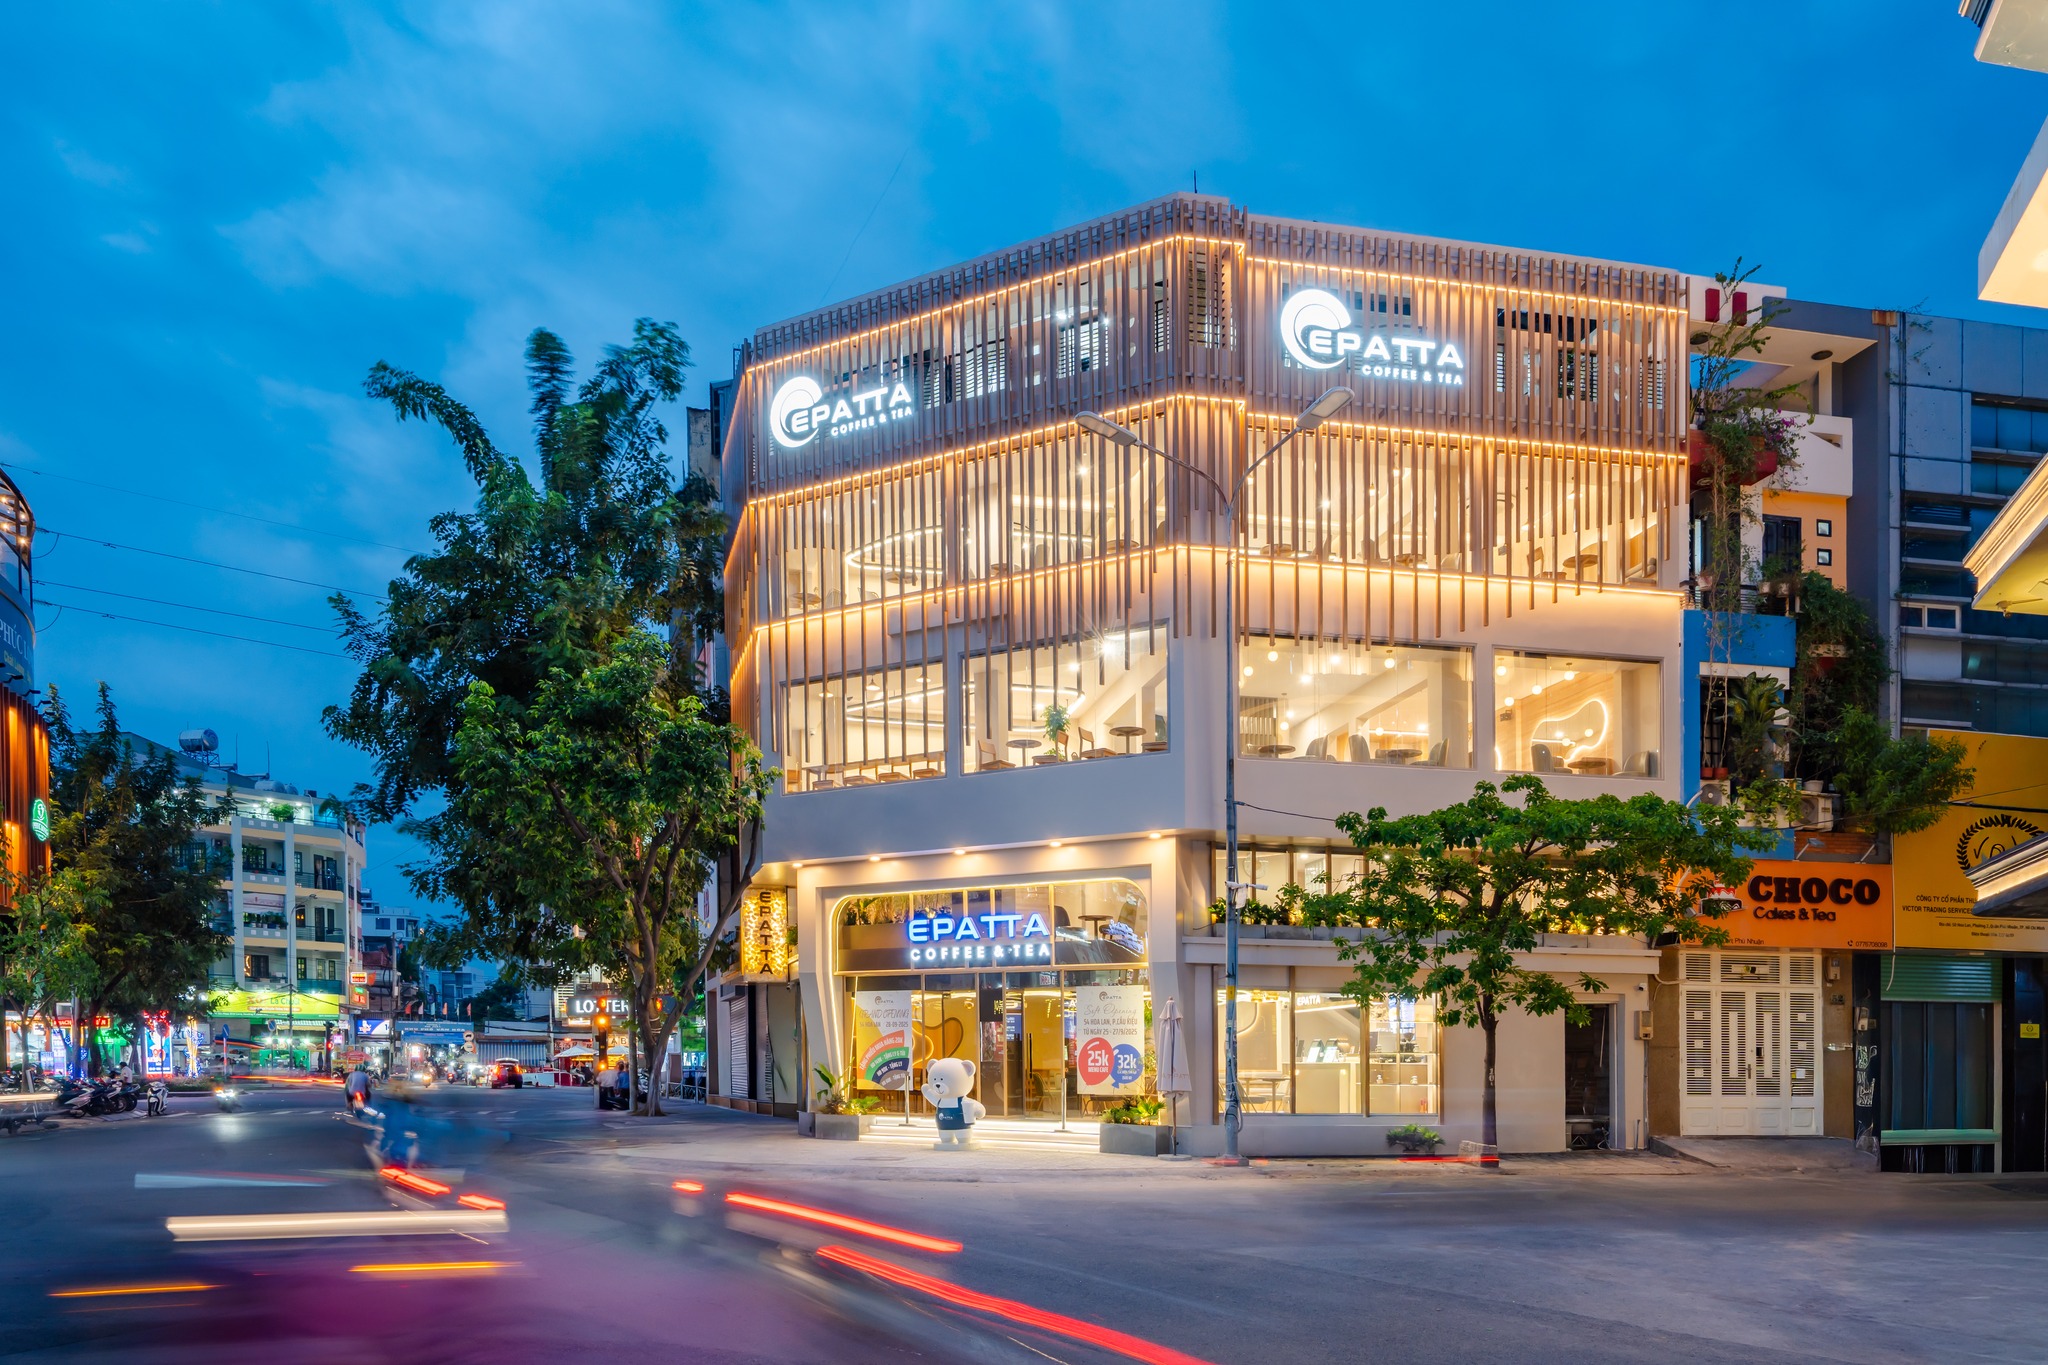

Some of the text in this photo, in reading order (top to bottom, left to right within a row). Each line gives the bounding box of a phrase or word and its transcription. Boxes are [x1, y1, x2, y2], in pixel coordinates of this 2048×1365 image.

[1309, 330, 1464, 369] EPATTA
[1362, 365, 1462, 385] COFFEE & TEA
[791, 383, 911, 433] EPATTA
[831, 406, 913, 436] COFFEE & TEA
[0, 618, 23, 655] HÚC
[1748, 875, 1881, 905] CHOCO
[908, 913, 1051, 942] EPATTA
[1753, 906, 1836, 921] Cakes & Tea
[759, 891, 773, 975] EPATTA
[910, 944, 1050, 961] COFFEE & TEA
[575, 1000, 628, 1013] LOTER
[1087, 1050, 1109, 1066] 25k
[1117, 1054, 1137, 1069] 32k
